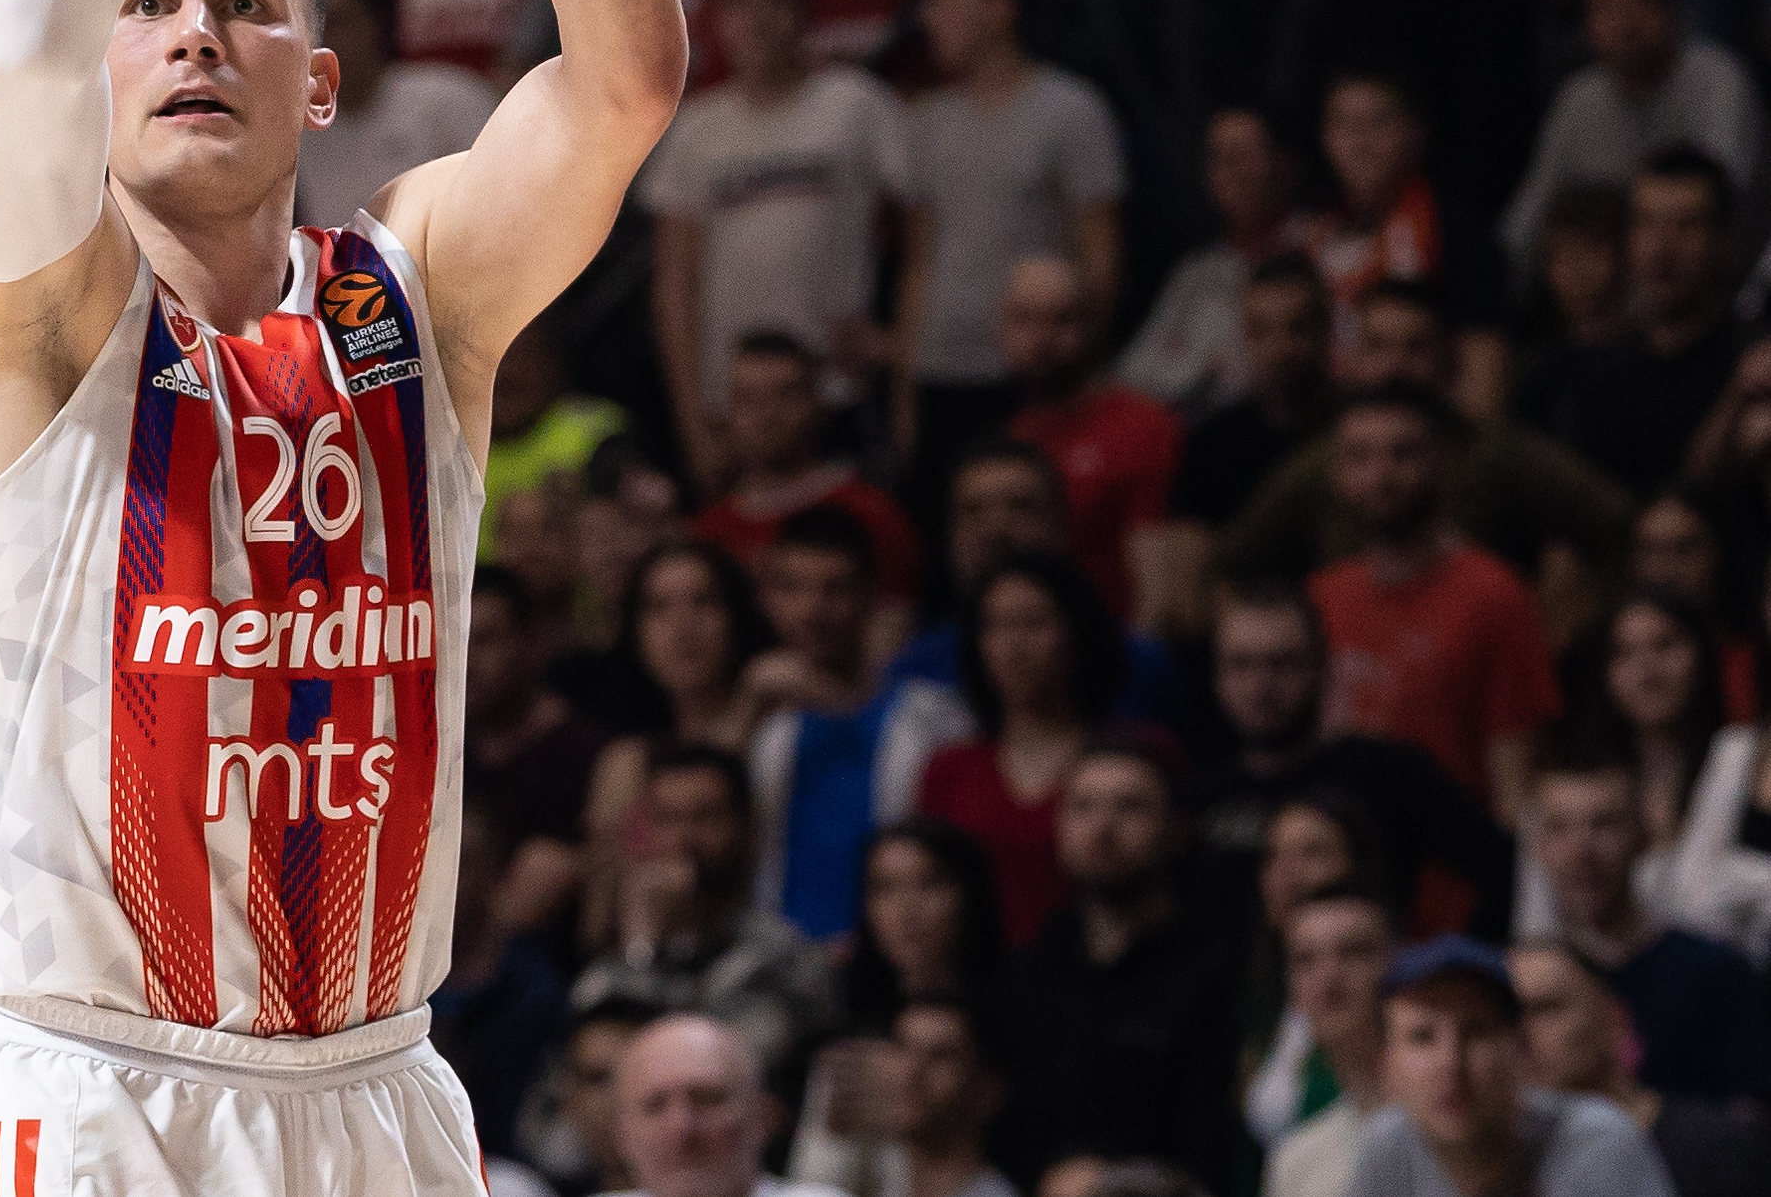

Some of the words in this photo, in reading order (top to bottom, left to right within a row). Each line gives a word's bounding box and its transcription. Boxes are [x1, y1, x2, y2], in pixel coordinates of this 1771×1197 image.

[342, 316, 398, 344] TURKISH
[347, 327, 401, 353] AIRLINES
[152, 375, 211, 401] adidas
[347, 360, 423, 393] oneteam
[242, 412, 363, 542] 26
[205, 722, 395, 820] mts
